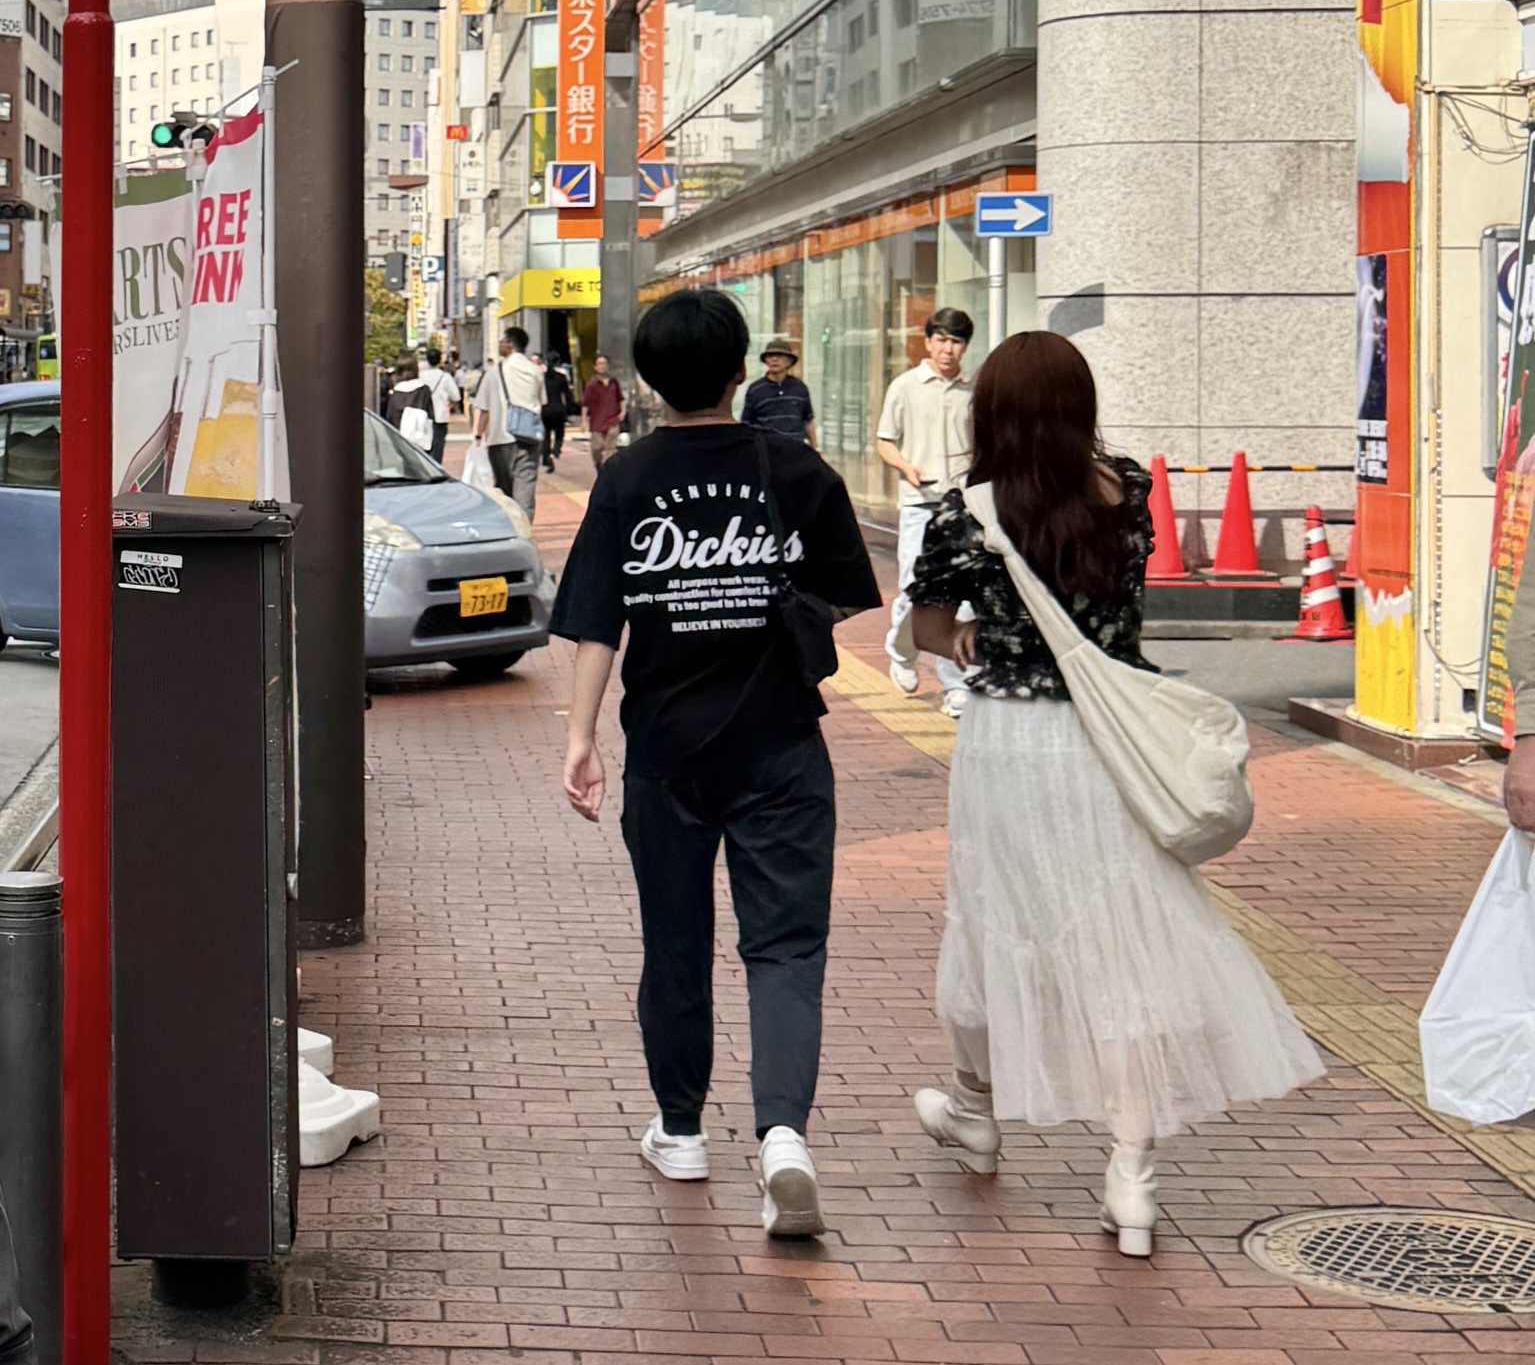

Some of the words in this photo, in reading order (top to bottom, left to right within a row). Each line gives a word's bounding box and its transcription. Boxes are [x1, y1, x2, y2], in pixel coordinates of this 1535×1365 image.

[424, 258, 439, 281] P
[566, 281, 583, 292] ME
[622, 516, 804, 575] Dickies
[138, 554, 168, 562] HELLO
[682, 578, 718, 589] purpose
[720, 577, 742, 585] work
[471, 592, 505, 613] 73-17
[623, 593, 653, 606] Quality
[655, 587, 710, 601] construction
[711, 588, 724, 597] for
[725, 586, 761, 596] comfort
[684, 602, 699, 610] too
[700, 600, 723, 611] good
[724, 599, 735, 608] to
[736, 598, 747, 607] be
[672, 620, 709, 632] BELIEVE
[710, 619, 721, 629] IN
